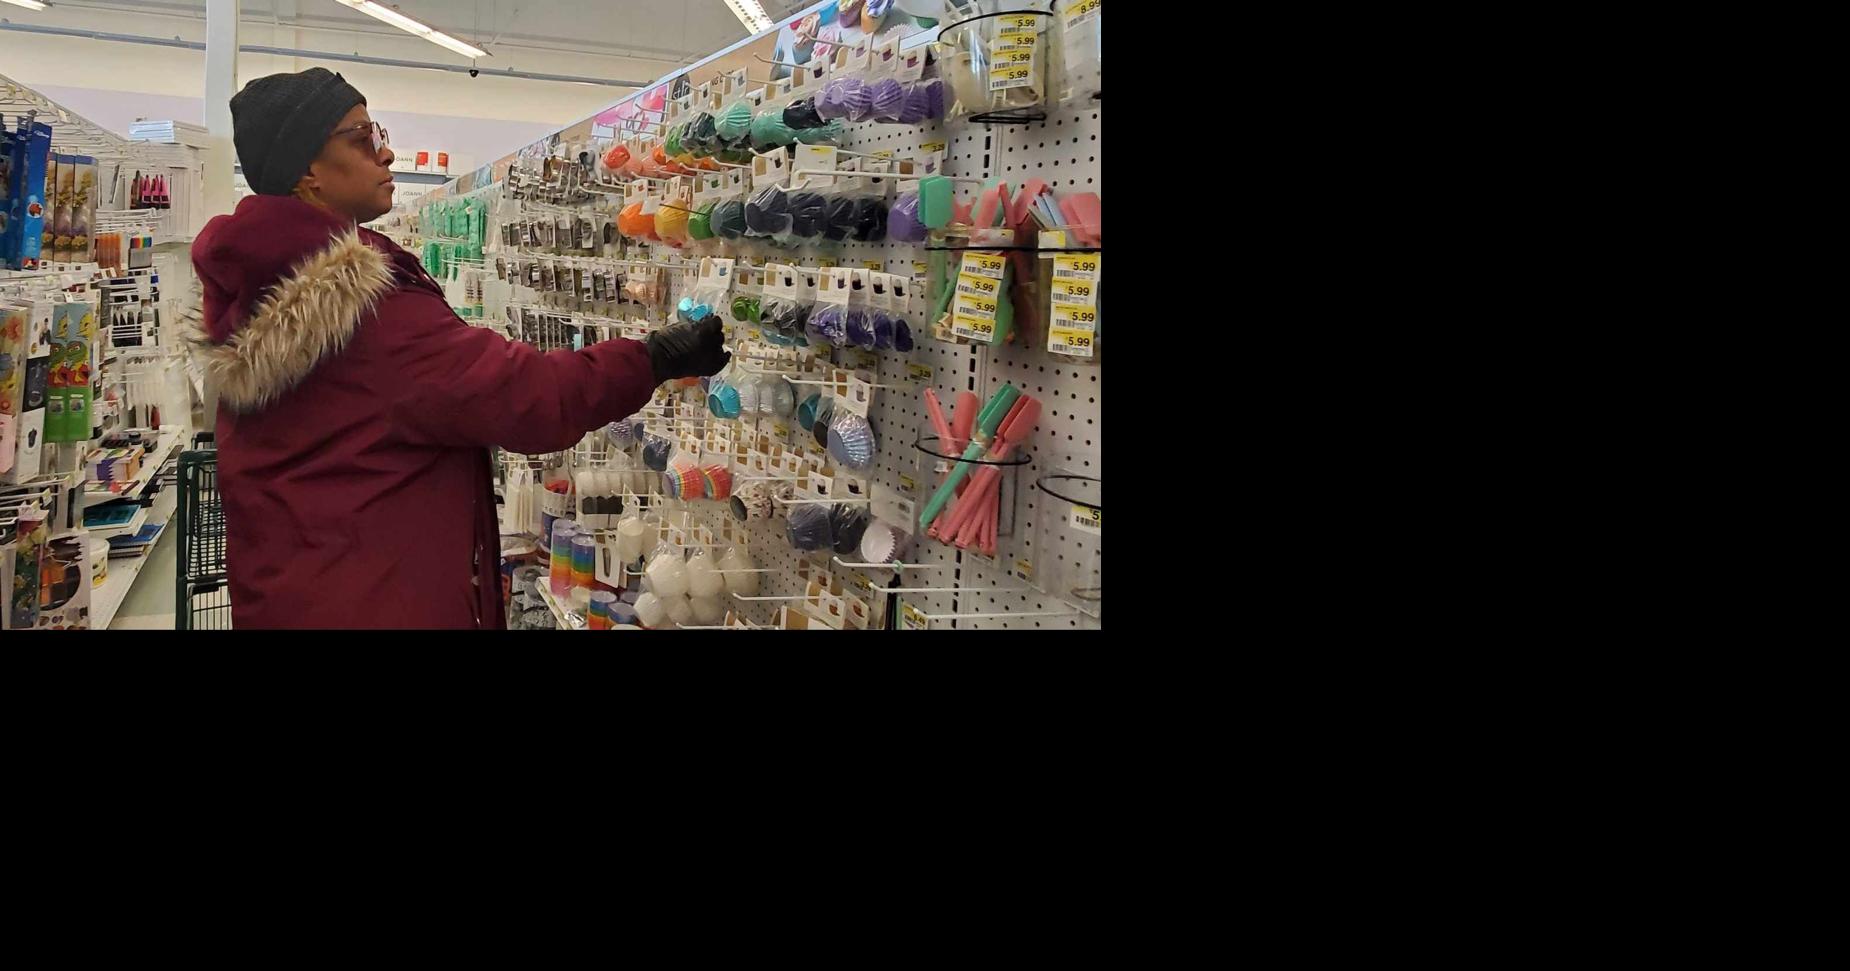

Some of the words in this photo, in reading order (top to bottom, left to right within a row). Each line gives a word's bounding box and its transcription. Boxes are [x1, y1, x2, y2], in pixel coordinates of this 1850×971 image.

[1017, 19, 1035, 27] 5.99
[1017, 37, 1035, 45] 5.99
[1011, 53, 1031, 62] 5.99
[1009, 70, 1028, 80] 5.99
[981, 260, 1002, 270] 5.99
[1073, 261, 1096, 271] 5.99
[974, 281, 994, 292] 5.99
[1068, 285, 1090, 296] 5.99
[975, 302, 996, 312] 5.99
[1072, 311, 1095, 322] 5.99
[972, 323, 993, 333] 5.99
[1068, 336, 1090, 347] 5.99
